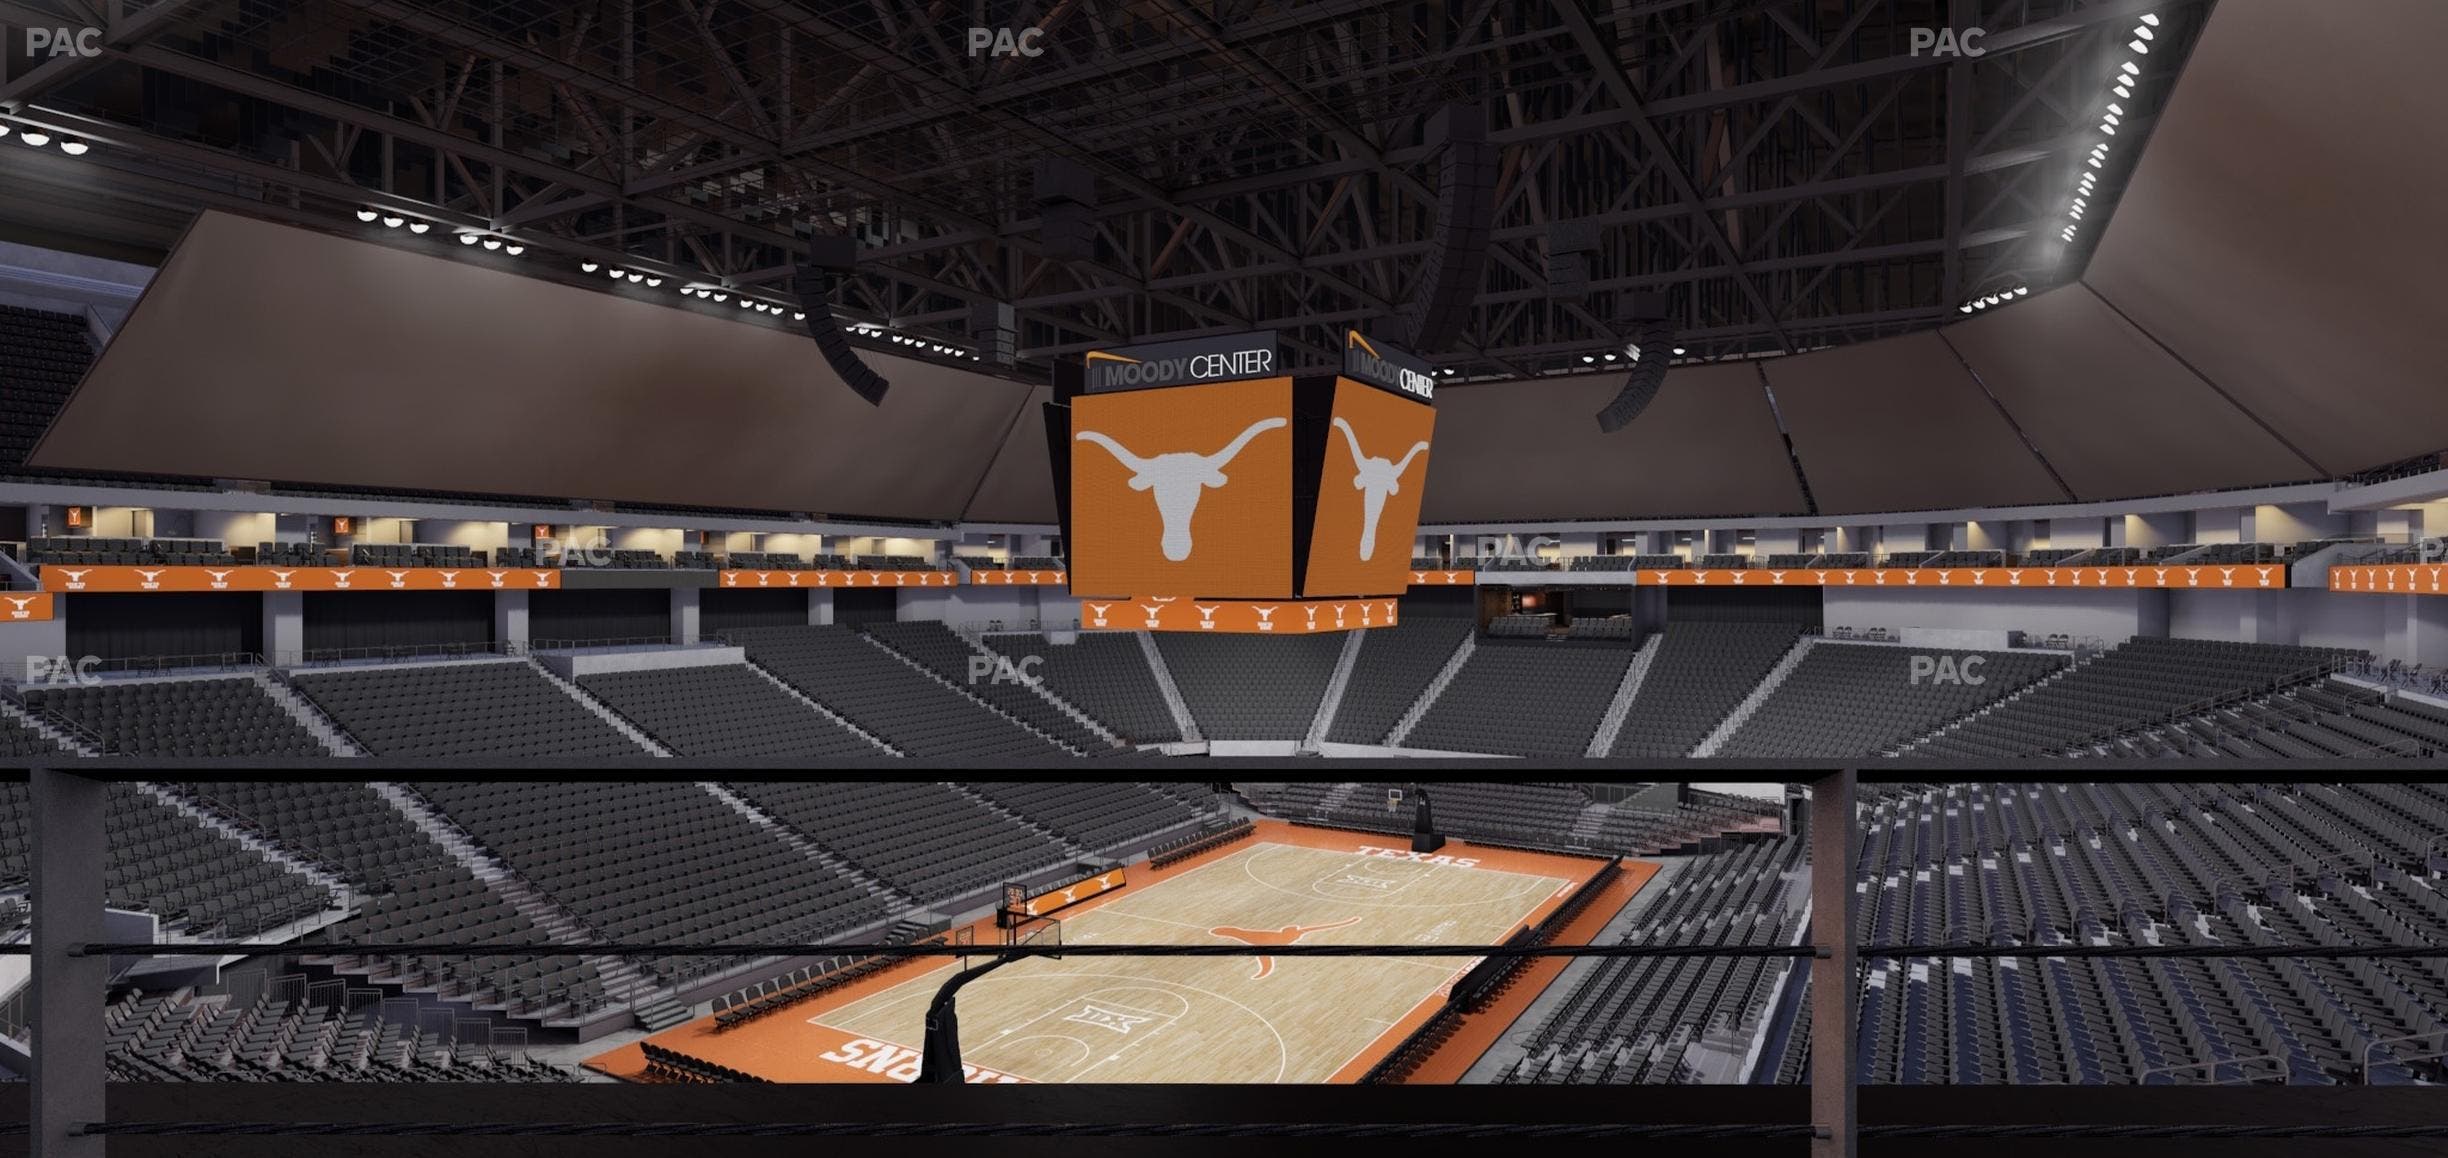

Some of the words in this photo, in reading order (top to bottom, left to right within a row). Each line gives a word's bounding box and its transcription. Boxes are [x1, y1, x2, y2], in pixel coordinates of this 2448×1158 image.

[1104, 358, 1188, 387] MOODY
[1190, 349, 1272, 379] CENTER
[1400, 368, 1434, 399] CENTER
[1355, 845, 1481, 868] TEXAS
